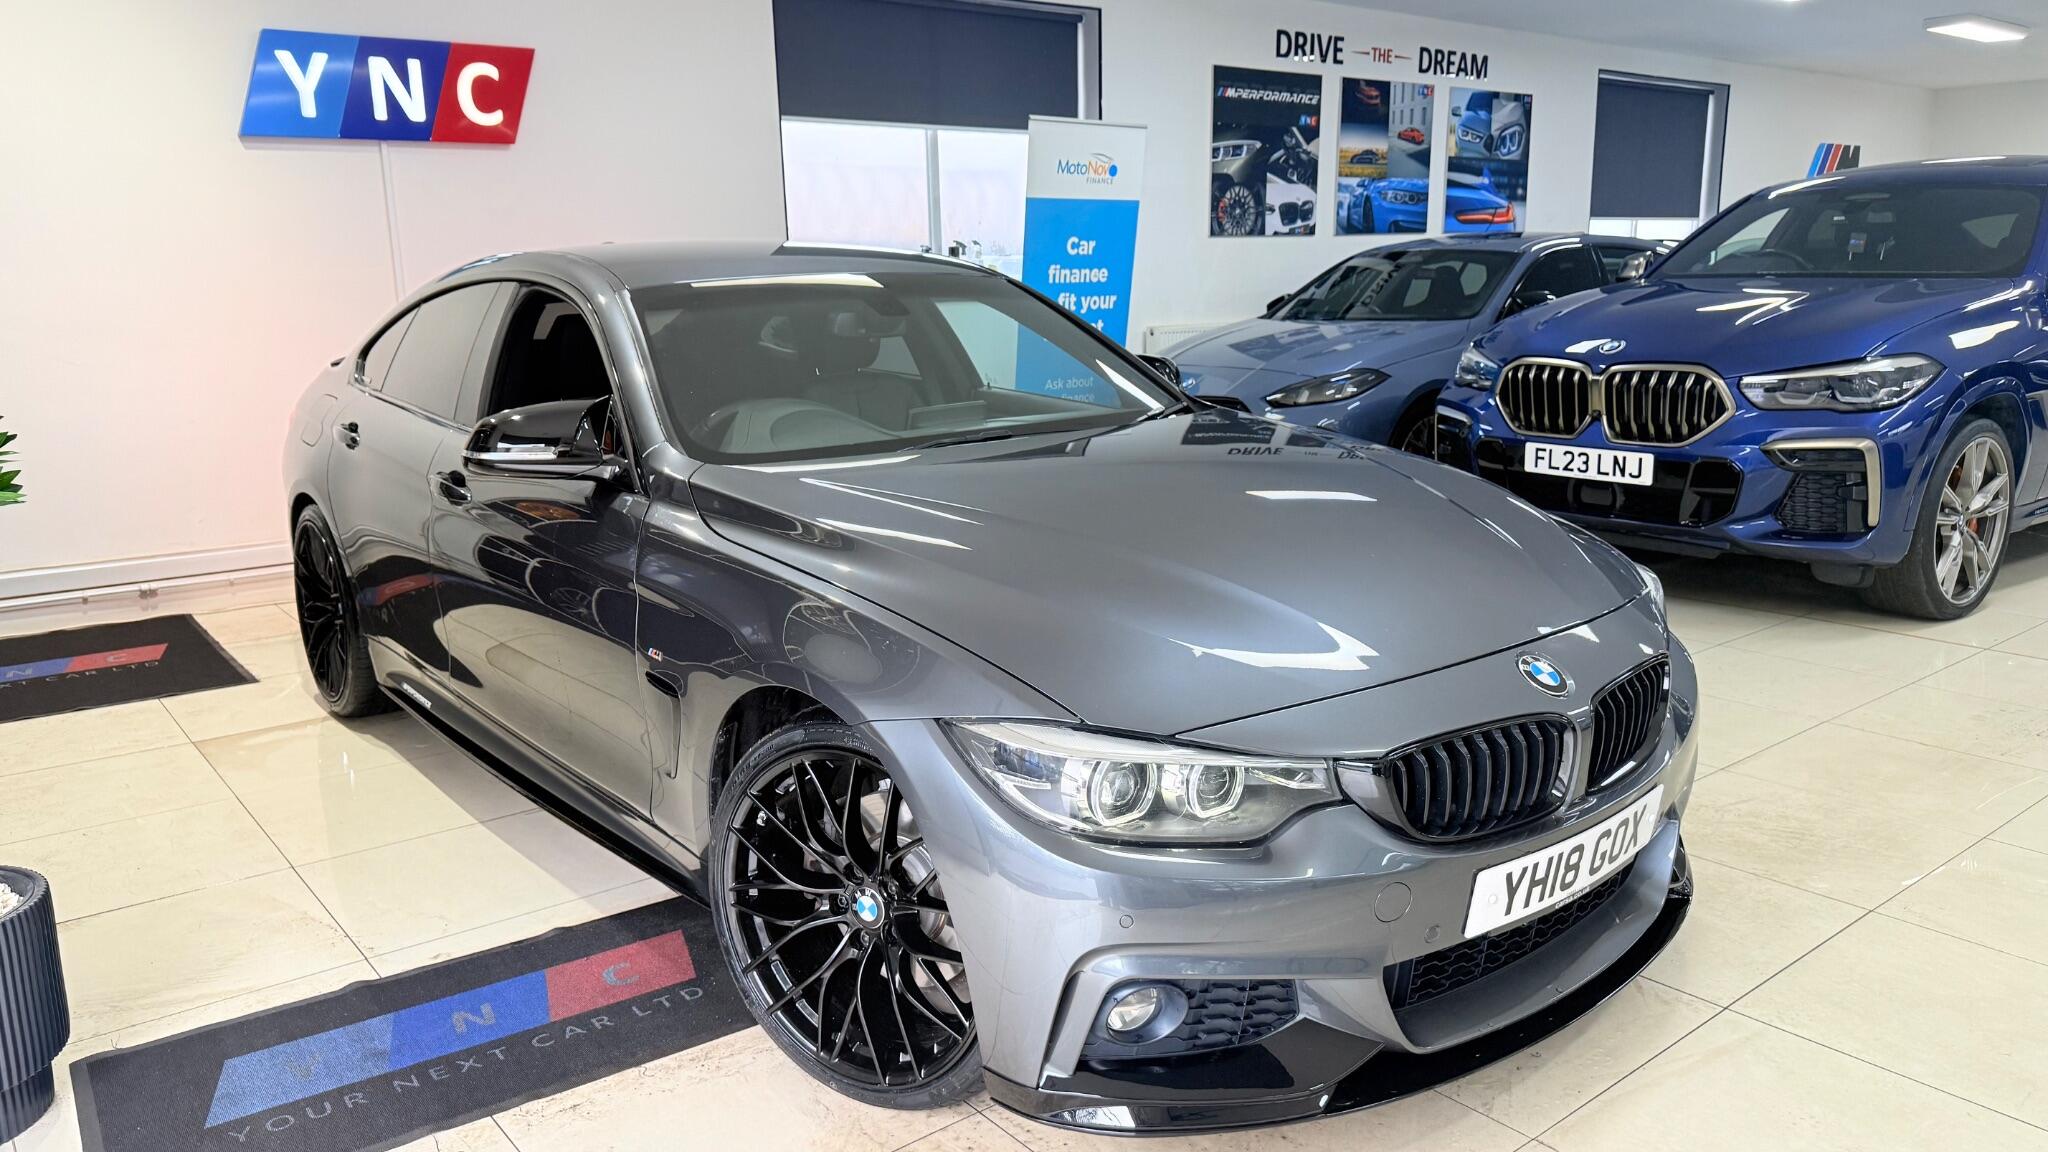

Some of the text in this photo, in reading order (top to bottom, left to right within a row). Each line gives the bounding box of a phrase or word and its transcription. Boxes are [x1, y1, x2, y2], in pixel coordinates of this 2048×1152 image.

[1276, 29, 1489, 80] DRIVE THE DREAM
[273, 49, 504, 127] YNC
[1066, 236, 1096, 255] Car
[1048, 264, 1108, 284] finance
[1080, 294, 1117, 314] your
[1044, 379, 1064, 391] Ask
[1534, 447, 1643, 479] FL23 LNJ
[112, 661, 159, 672] LTD
[1504, 803, 1648, 916] YH18 GOX
[228, 986, 704, 1143] YOUR NEXT CAR LTD
